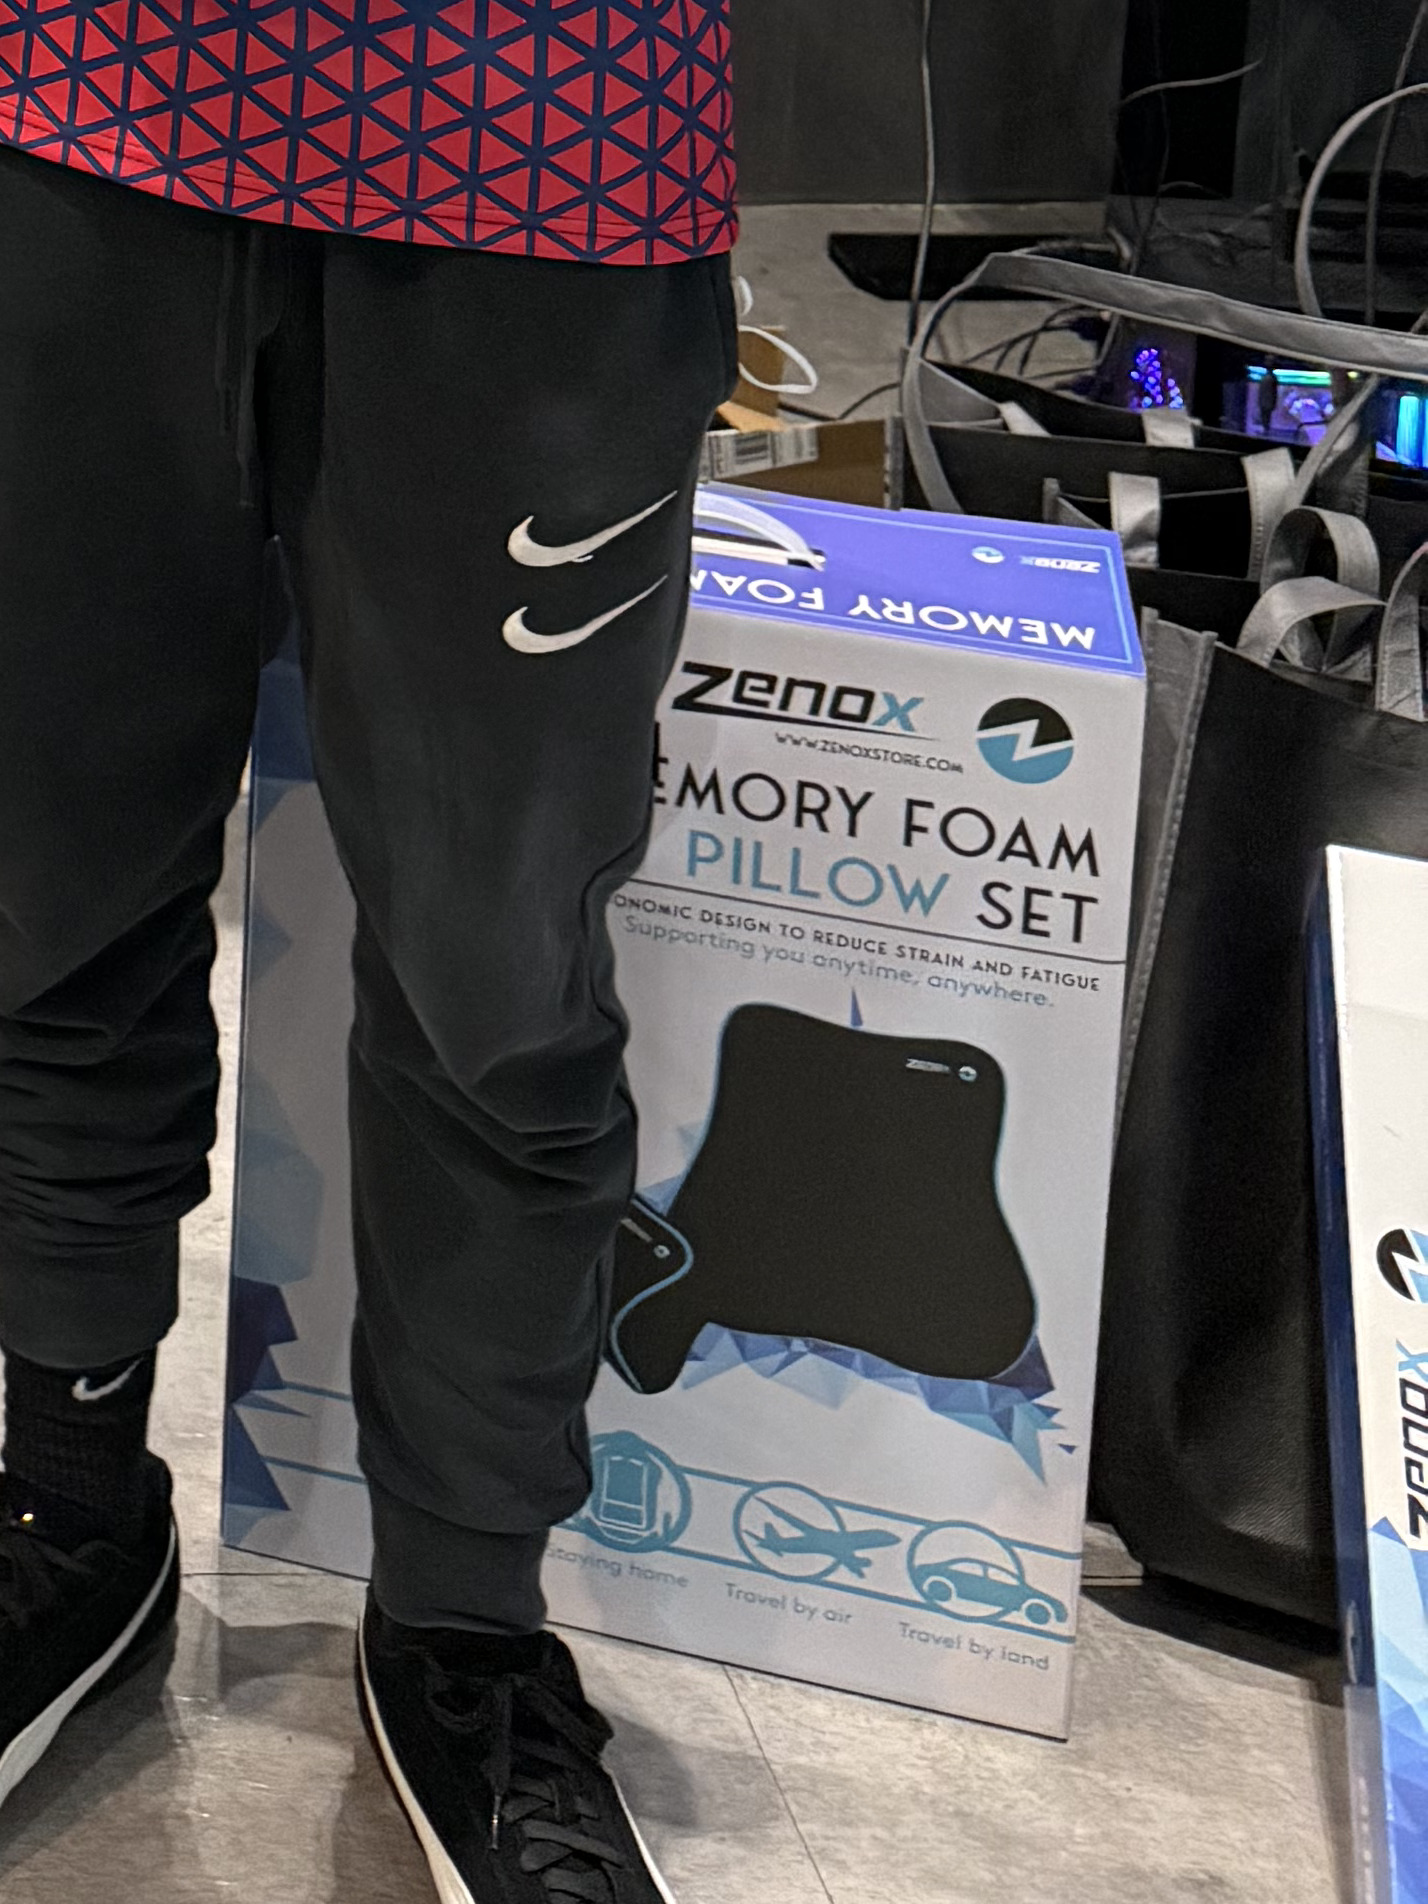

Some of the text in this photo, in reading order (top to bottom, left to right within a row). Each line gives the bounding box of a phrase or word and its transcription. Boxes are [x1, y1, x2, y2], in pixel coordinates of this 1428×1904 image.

[848, 593, 1096, 652] MEMORY
[902, 797, 1101, 878] FOAM
[686, 829, 1100, 945] PILLOW SET
[625, 915, 756, 960] Supporting
[761, 942, 806, 970] you
[699, 908, 772, 935] DESIGN
[780, 923, 806, 941] TO
[813, 930, 888, 957] REDUCE
[896, 945, 965, 970] STRAIN
[972, 959, 1013, 978] AND
[1021, 965, 1101, 992] FATIGUE
[628, 1561, 690, 1590] home
[724, 1581, 852, 1626] Travel by air
[899, 1621, 1050, 1673] Travel by land
